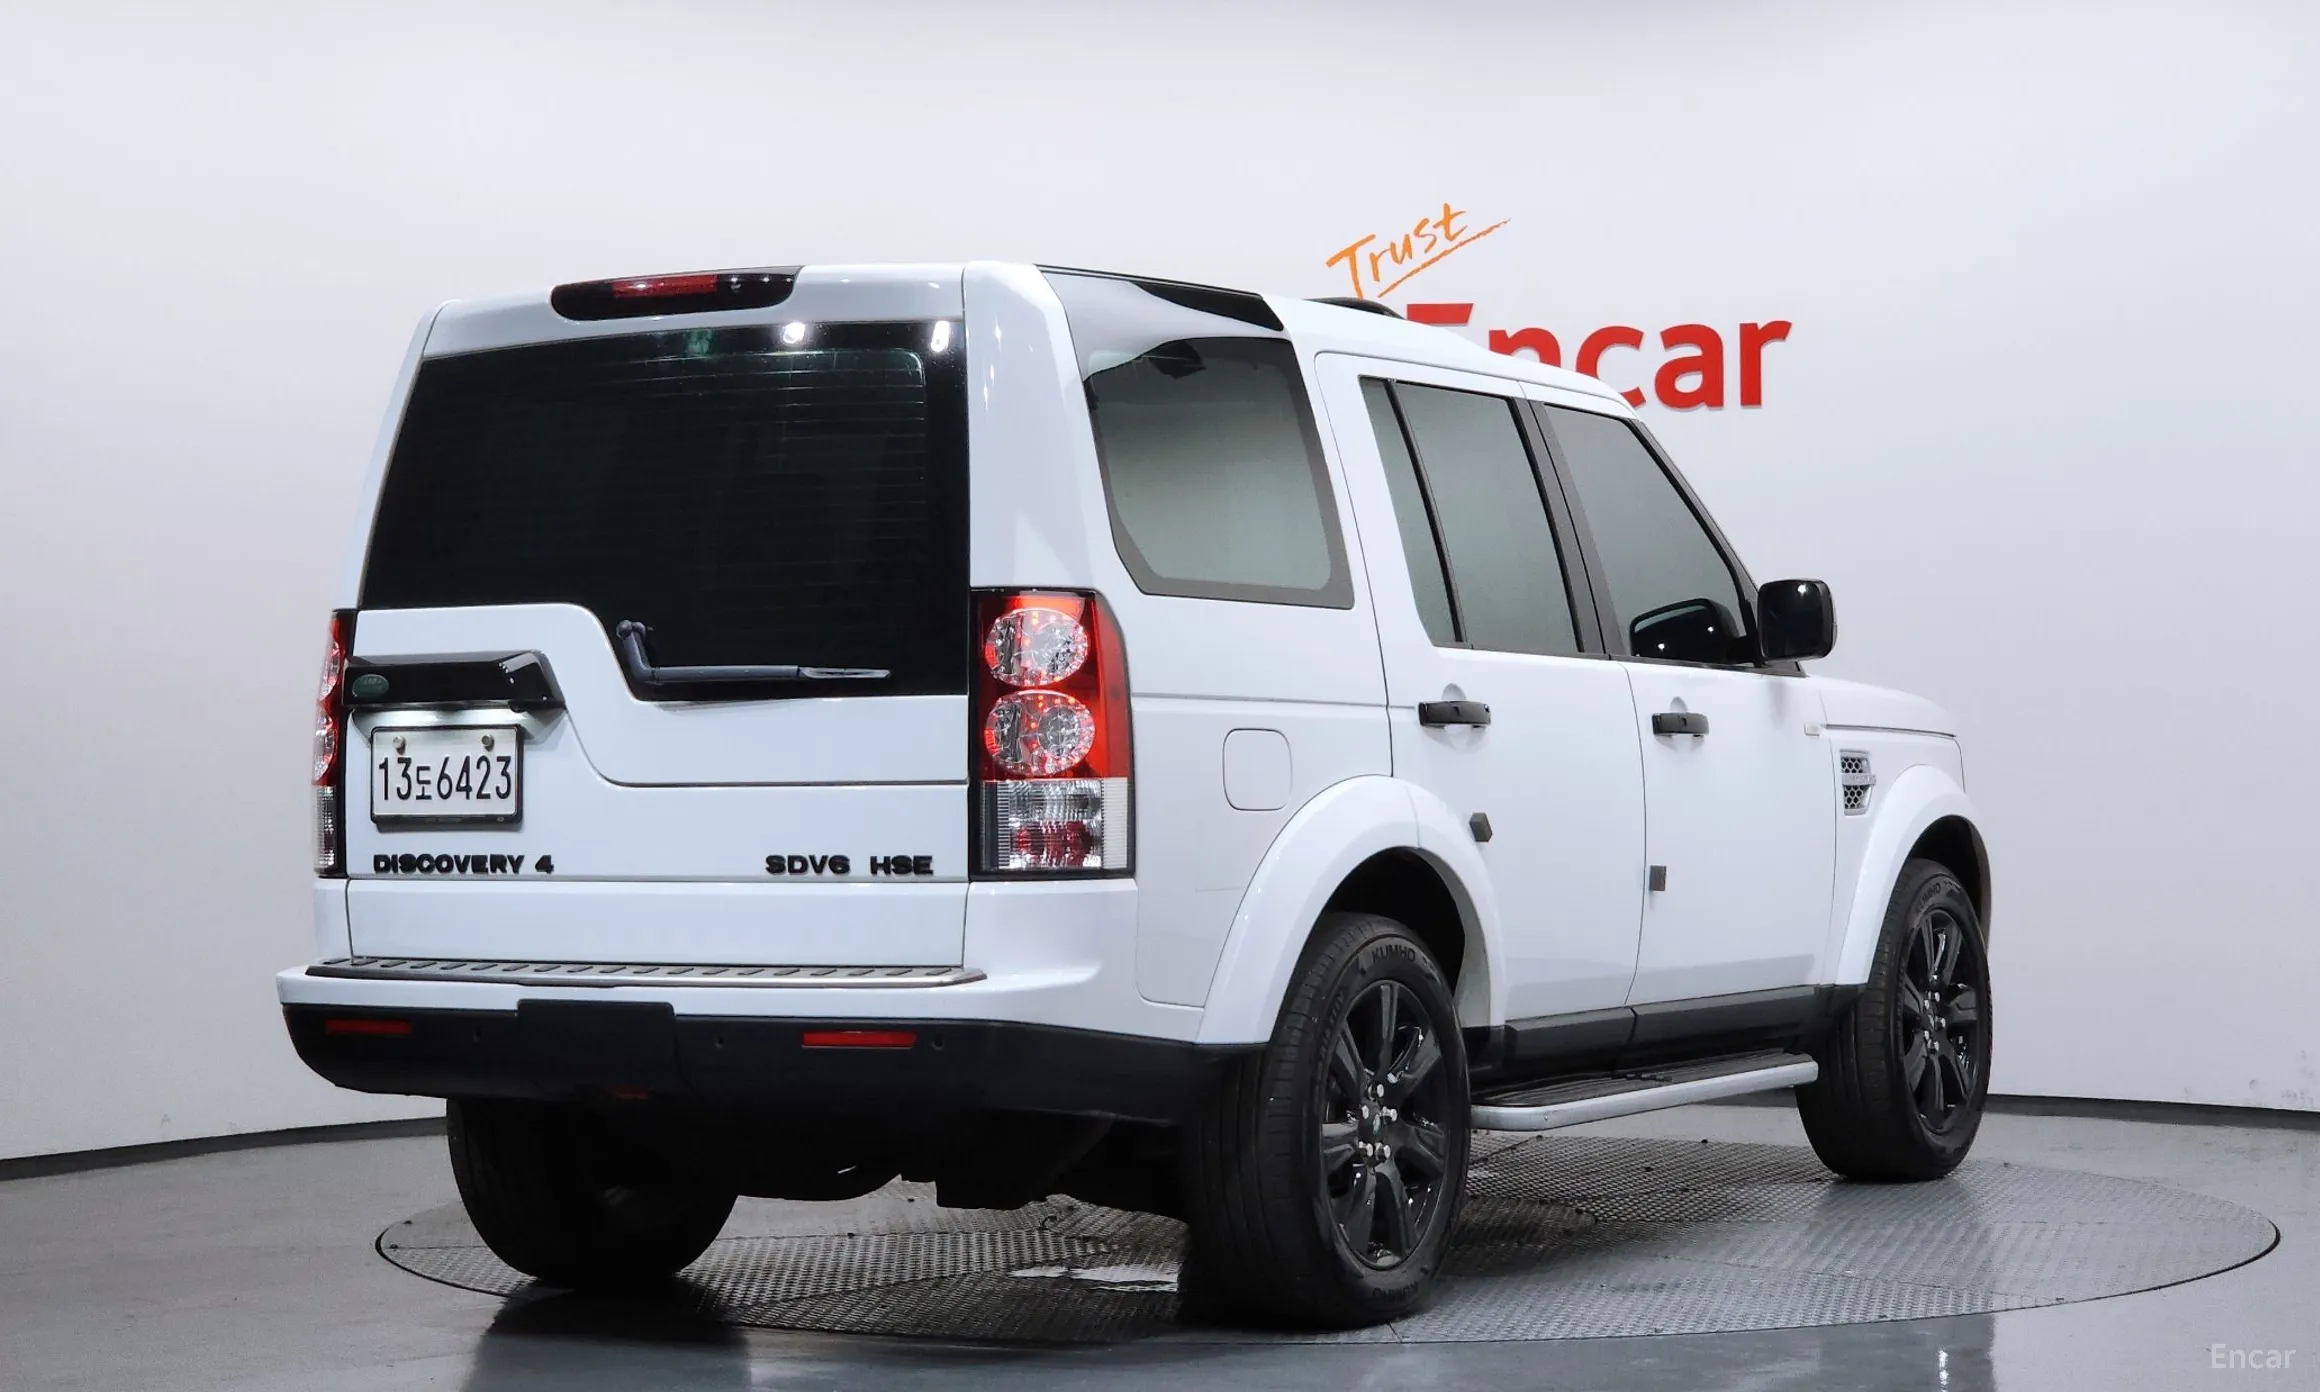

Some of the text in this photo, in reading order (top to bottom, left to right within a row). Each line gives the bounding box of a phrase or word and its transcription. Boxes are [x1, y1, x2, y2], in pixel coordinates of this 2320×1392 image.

[1326, 203, 1467, 300] Trust
[378, 754, 512, 801] 13도6423
[373, 854, 555, 874] DISCOVERY 4
[765, 854, 934, 876] SDV6 HSE
[1371, 943, 1416, 963] KUMHO
